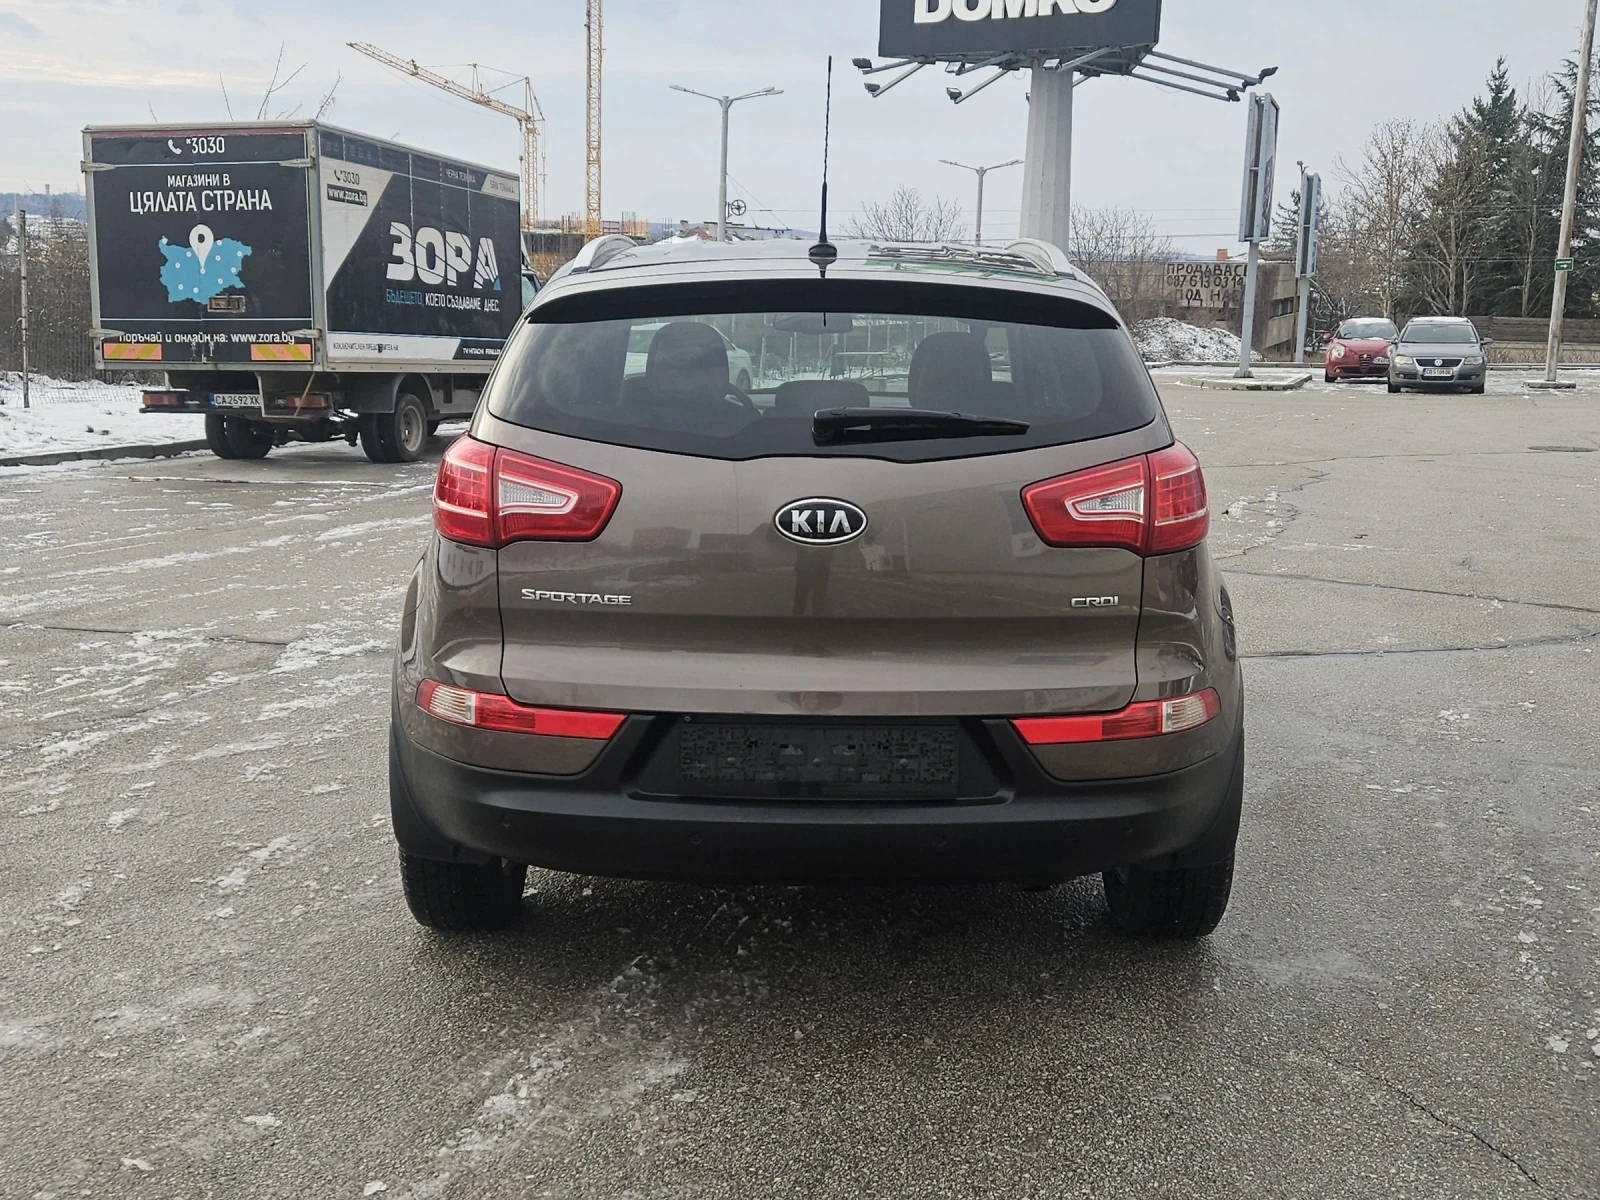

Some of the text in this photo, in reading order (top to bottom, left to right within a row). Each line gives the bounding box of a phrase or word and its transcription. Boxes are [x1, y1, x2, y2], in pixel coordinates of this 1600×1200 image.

[167, 173, 231, 187] МАГАЗИНИ В
[129, 189, 273, 215] ЦЯЛАТА СТРАНА
[386, 221, 501, 291] ЗОРА
[425, 292, 446, 307] КОЕТО
[174, 331, 211, 343] онлайн
[213, 333, 229, 343] на:
[230, 331, 295, 345] www.zora.bg
[790, 509, 852, 533] KIA
[521, 588, 632, 606] SPORTAGE
